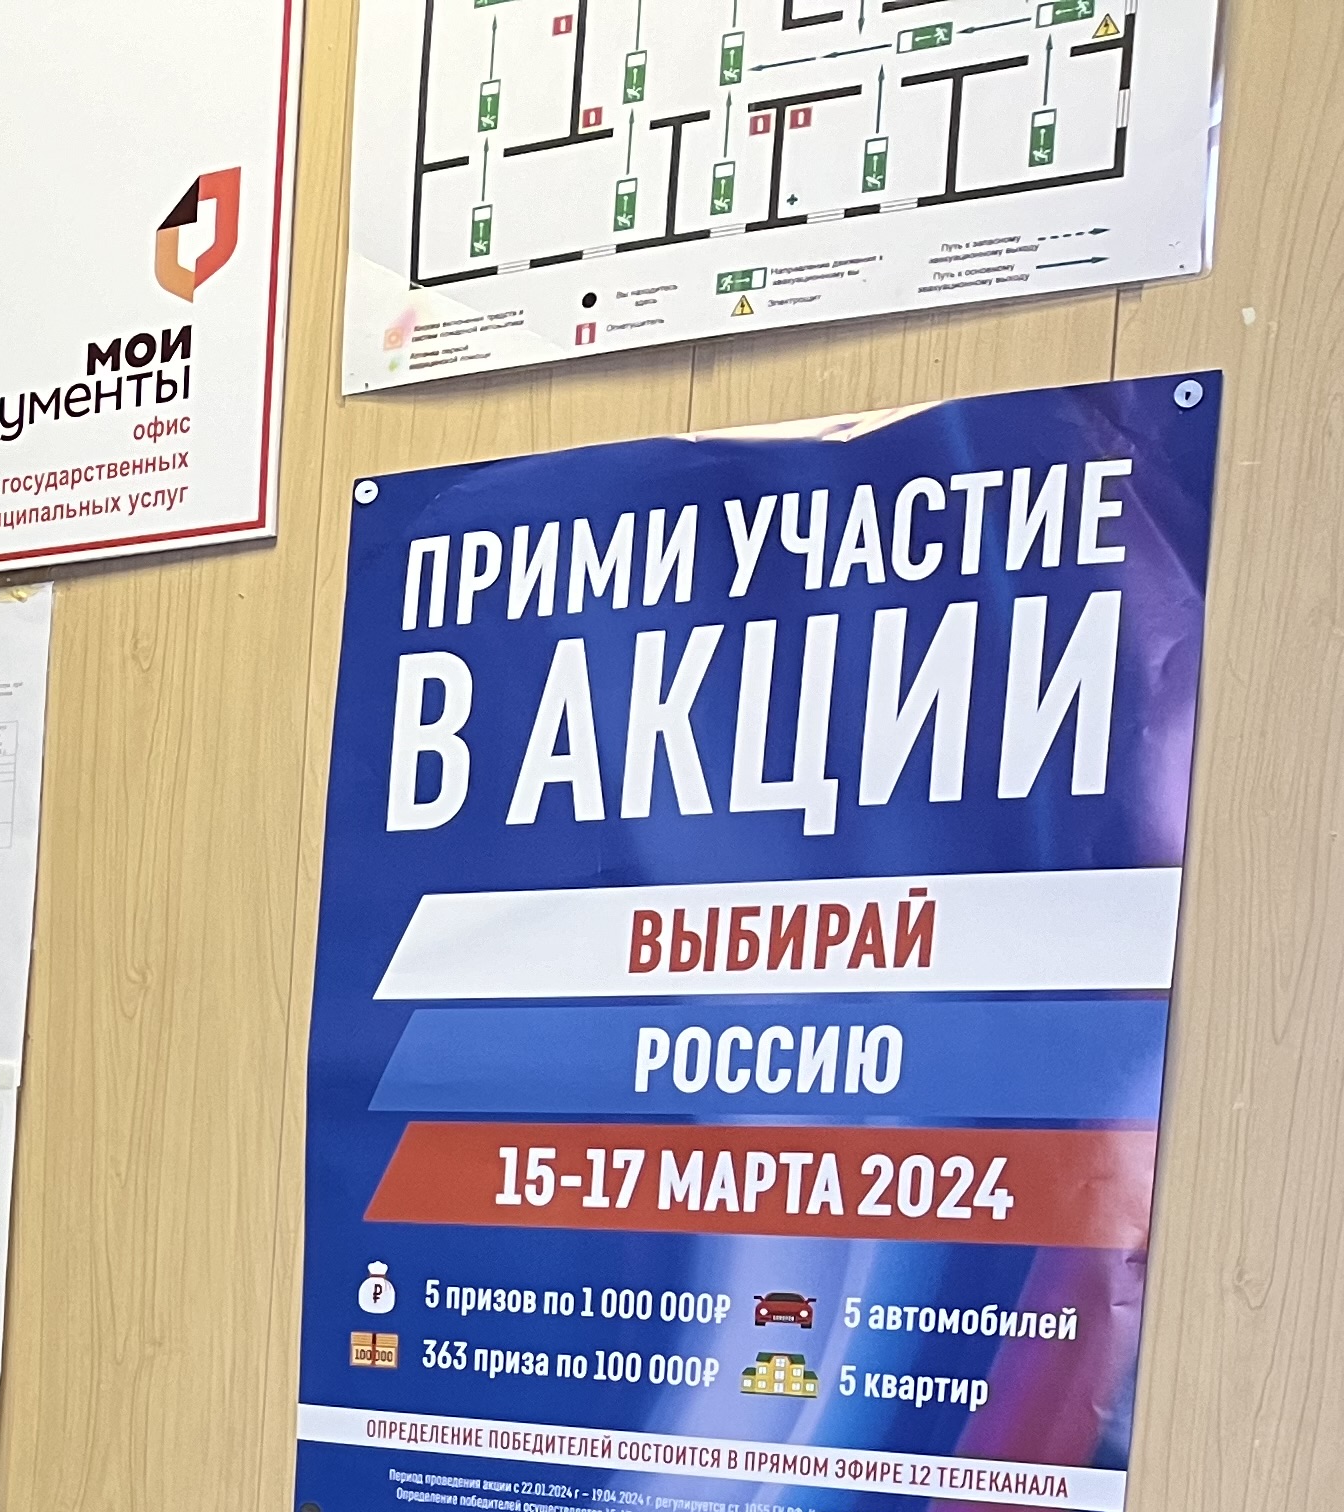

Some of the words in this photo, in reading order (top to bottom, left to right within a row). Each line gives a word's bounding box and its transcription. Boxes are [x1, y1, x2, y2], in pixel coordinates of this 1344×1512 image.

[133, 415, 190, 442] офис
[1, 451, 189, 494] государственных
[128, 484, 188, 516] услуг
[401, 505, 698, 631] ПРИМИ
[724, 459, 1133, 598] УЧАСТИЕ
[385, 650, 474, 832] В
[506, 590, 1123, 836] АКЦИИ
[628, 887, 936, 973] ВЫБИРАЙ
[634, 1023, 904, 1095] РОССИЮ
[495, 1145, 645, 1209] 15-17
[657, 1151, 839, 1217] МАРТА
[860, 1153, 1014, 1220] 2024
[425, 1279, 440, 1308] 5
[446, 1284, 537, 1316] призов
[544, 1291, 574, 1316] по
[844, 1298, 861, 1328] 5
[868, 1304, 1078, 1340] автомобилей
[422, 1339, 467, 1370] 363
[474, 1348, 549, 1378] приза
[557, 1354, 587, 1379] по
[839, 1366, 856, 1396] 5
[864, 1372, 988, 1412] квартир
[366, 1418, 483, 1448] ОПРЕДЕЛЕНИЕ
[489, 1429, 612, 1459] ПОБЕДИТЕЛЕЙ
[618, 1441, 721, 1468] СОСТОИТСЯ
[727, 1452, 737, 1469] В
[744, 1452, 828, 1478] ПРЯМОМ
[835, 1458, 903, 1484] ЭФИРЕ
[910, 1465, 930, 1486] 12
[938, 1467, 1068, 1497] ТЕЛЕКАНАЛА
[389, 1468, 423, 1486] Период
[425, 1473, 481, 1490] проведения
[514, 1484, 519, 1493] с
[522, 1483, 572, 1499] 22.01.2024
[592, 1488, 644, 1506] 19.04.2024
[460, 1494, 521, 1512] победителей
